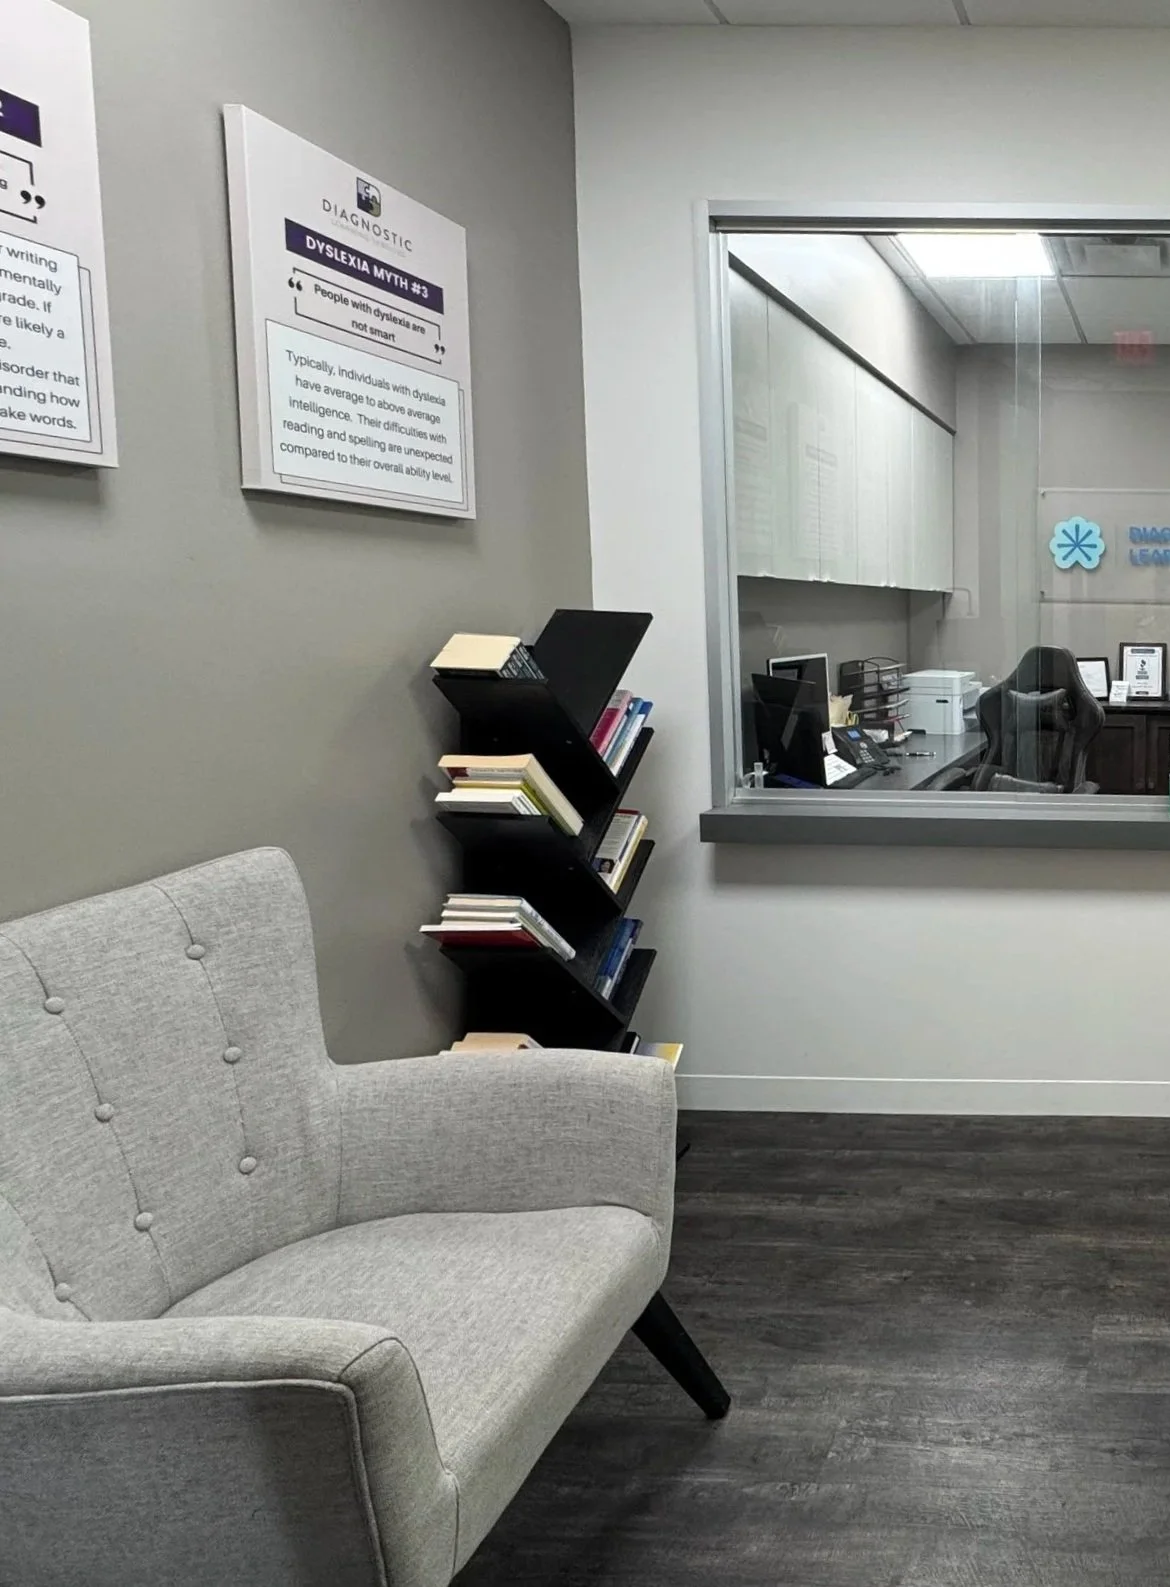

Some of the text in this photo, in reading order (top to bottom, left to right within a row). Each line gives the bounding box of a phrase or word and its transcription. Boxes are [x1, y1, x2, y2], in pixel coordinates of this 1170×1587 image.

[322, 199, 412, 252] DIAGNOSTIC
[6, 246, 58, 273] writing
[306, 235, 370, 274] DYSLEXIA
[373, 264, 409, 291] MYTH
[411, 281, 429, 298] #3
[0, 291, 52, 314] rade. If
[314, 284, 426, 335] People with dyslexia are
[15, 316, 53, 338] likely
[57, 329, 65, 339] a
[351, 319, 396, 342] not smart
[53, 371, 80, 386] that
[286, 349, 446, 407] Typically, individuals with dyslexia
[50, 391, 80, 408] how
[289, 396, 447, 445] intelligence. Their difficulties with
[295, 375, 441, 425] have average to above average
[29, 412, 77, 430] words.
[283, 419, 453, 465] reading and spelling are unexpected
[280, 441, 454, 483] compared to their overall ability level.
